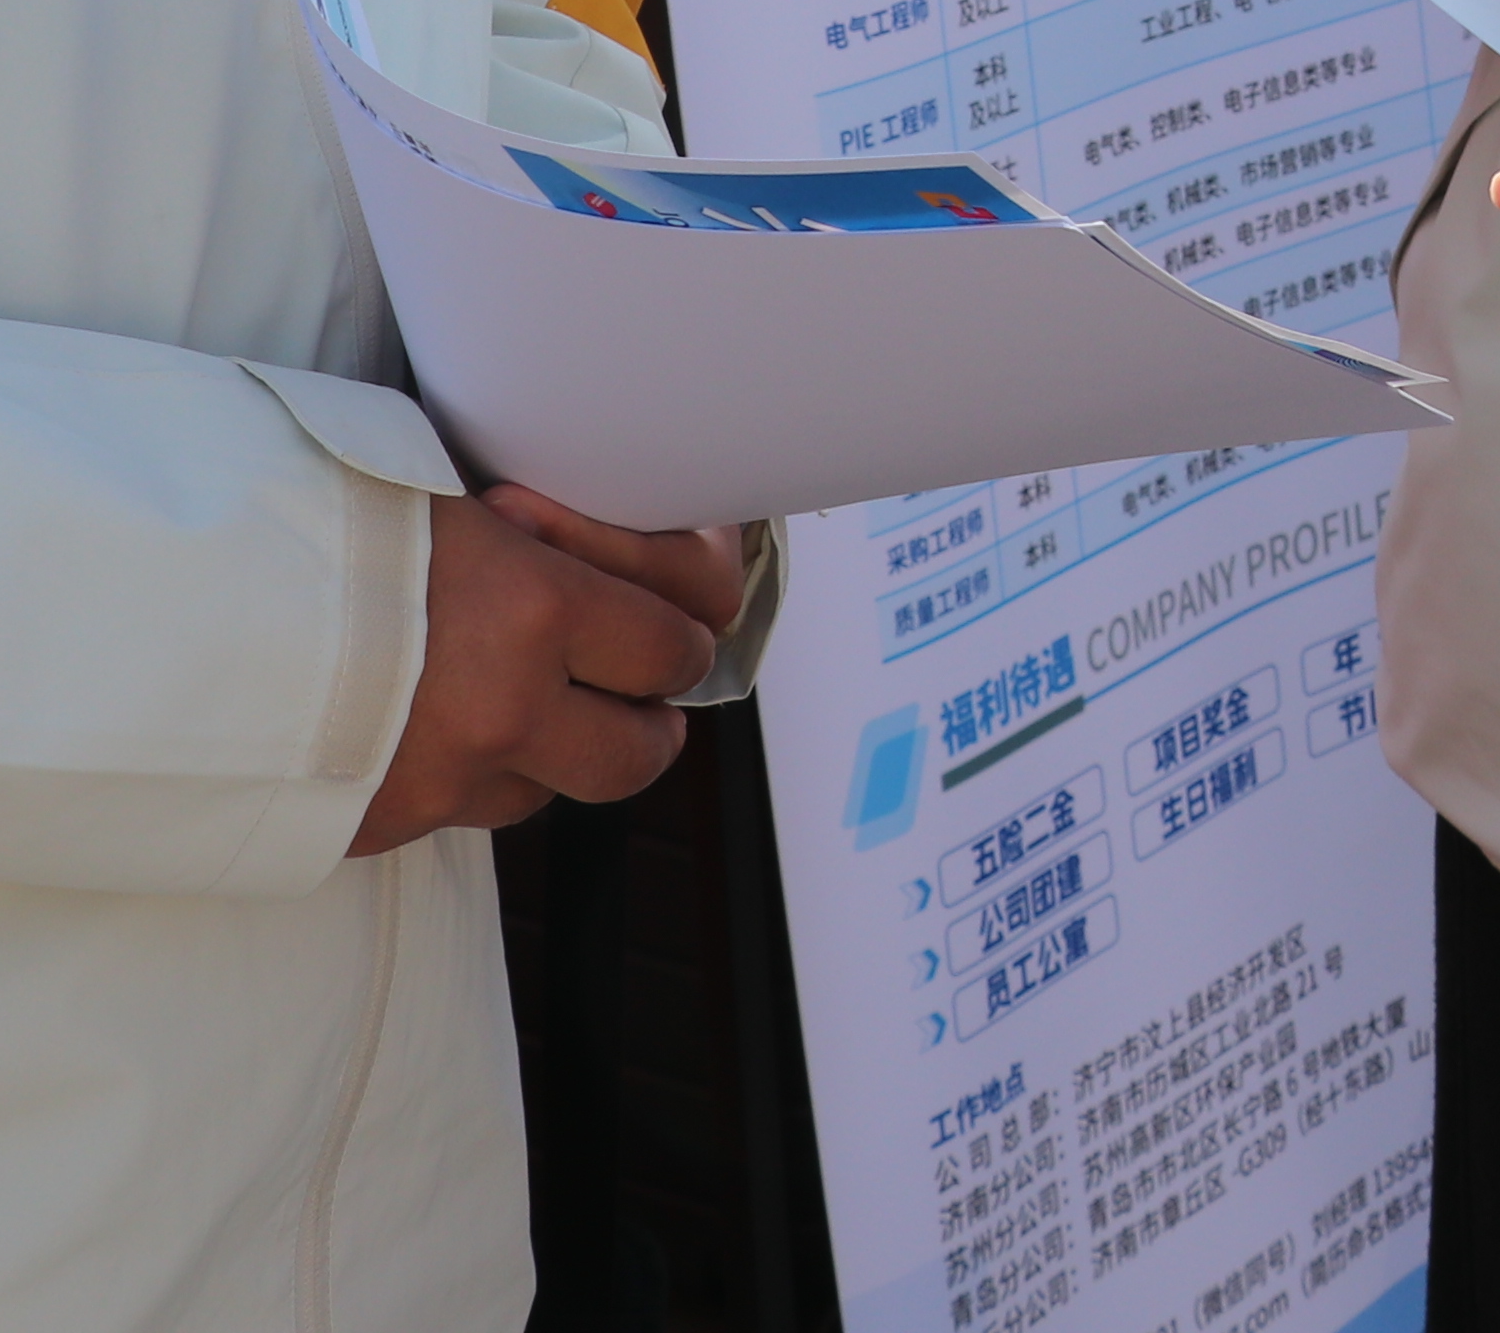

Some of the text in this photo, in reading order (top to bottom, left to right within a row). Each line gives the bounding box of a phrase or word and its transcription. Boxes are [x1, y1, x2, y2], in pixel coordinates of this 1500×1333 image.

[974, 52, 1008, 89] 本科
[840, 98, 939, 155] PIE 工程师
[968, 89, 1021, 131] 及以上
[1018, 474, 1052, 510] 本科
[886, 506, 985, 573] 采购工程师
[1023, 532, 1058, 569] 本科
[894, 566, 991, 638] 质量工程师
[939, 635, 1077, 758] 福利待遇
[1086, 556, 1235, 673] COMPANY
[1152, 686, 1252, 774] 项目奖金
[1159, 748, 1258, 840] 生日福利
[978, 852, 1084, 955] 公司团建
[985, 913, 1091, 1020] 员工公寓
[930, 1062, 1027, 1149] 工作地点
